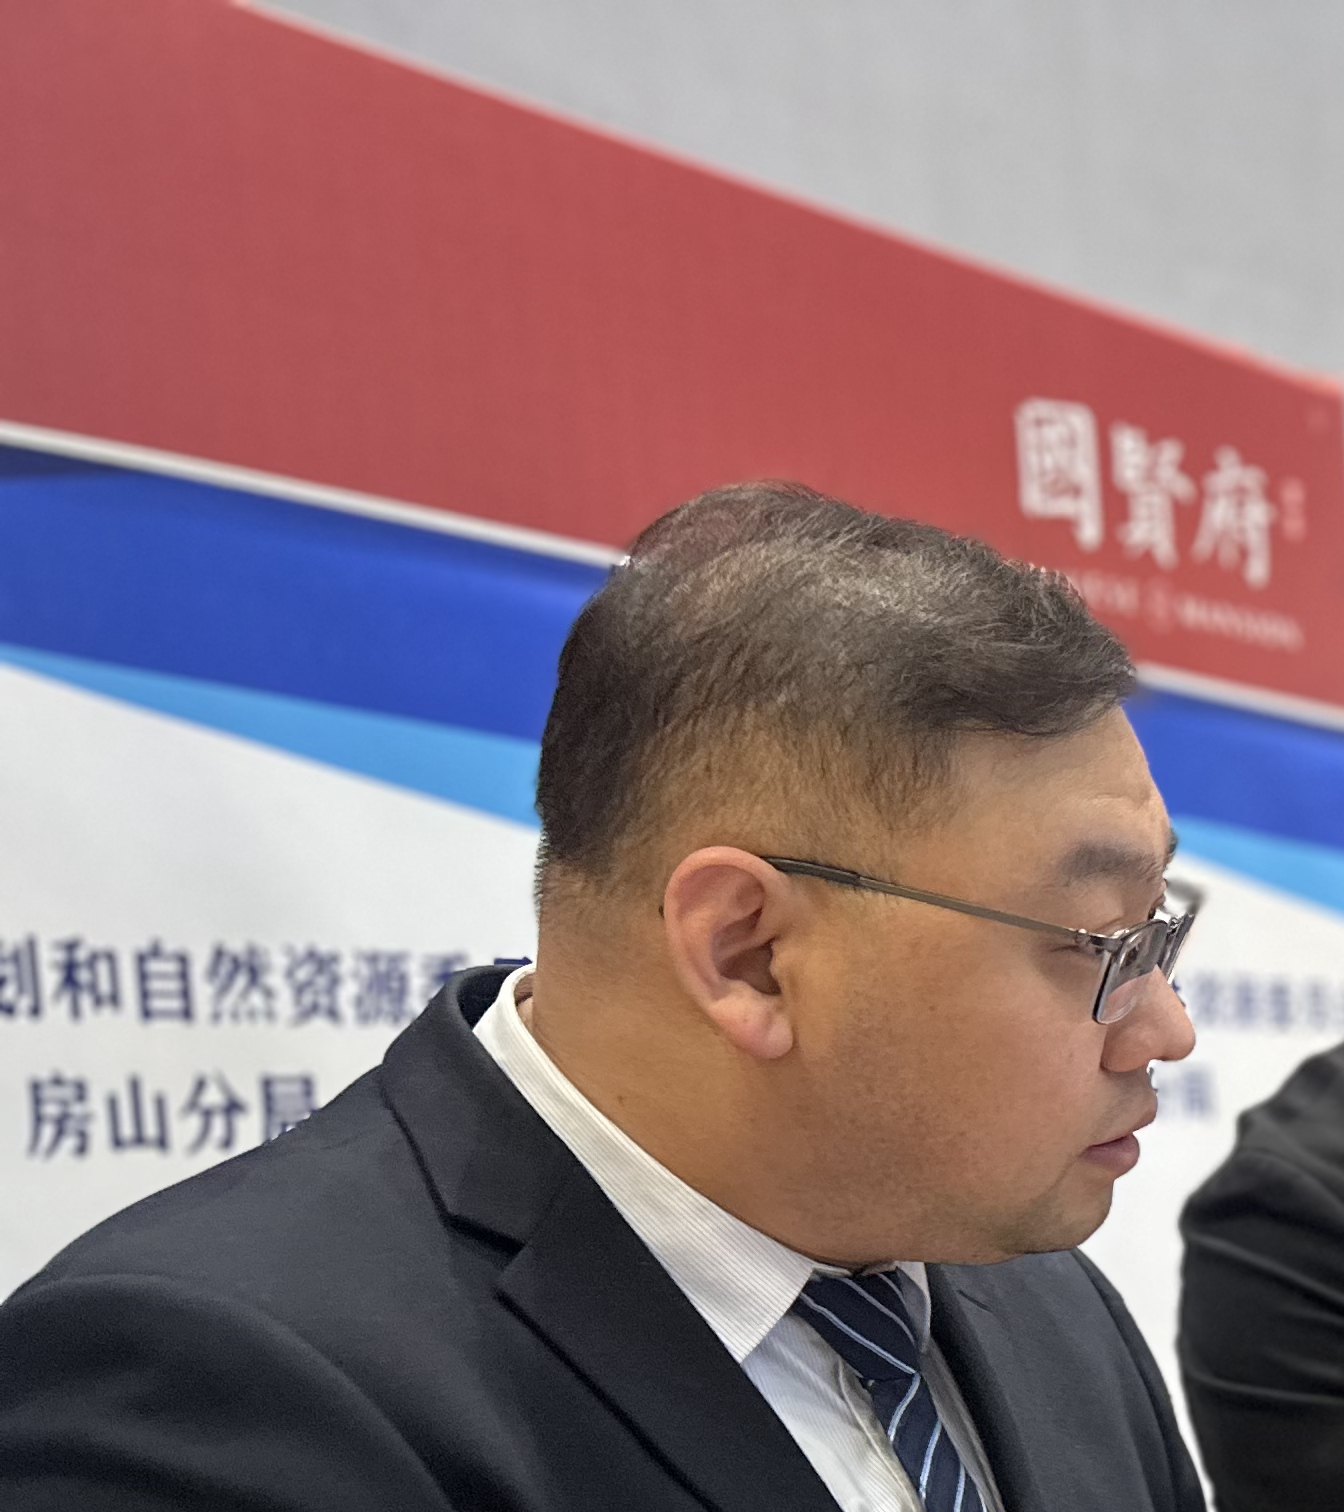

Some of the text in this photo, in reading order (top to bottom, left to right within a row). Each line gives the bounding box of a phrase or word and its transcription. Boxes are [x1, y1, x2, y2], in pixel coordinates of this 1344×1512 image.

[0, 932, 535, 1029] 划和自然资源
[26, 1070, 318, 1158] 房山分局
